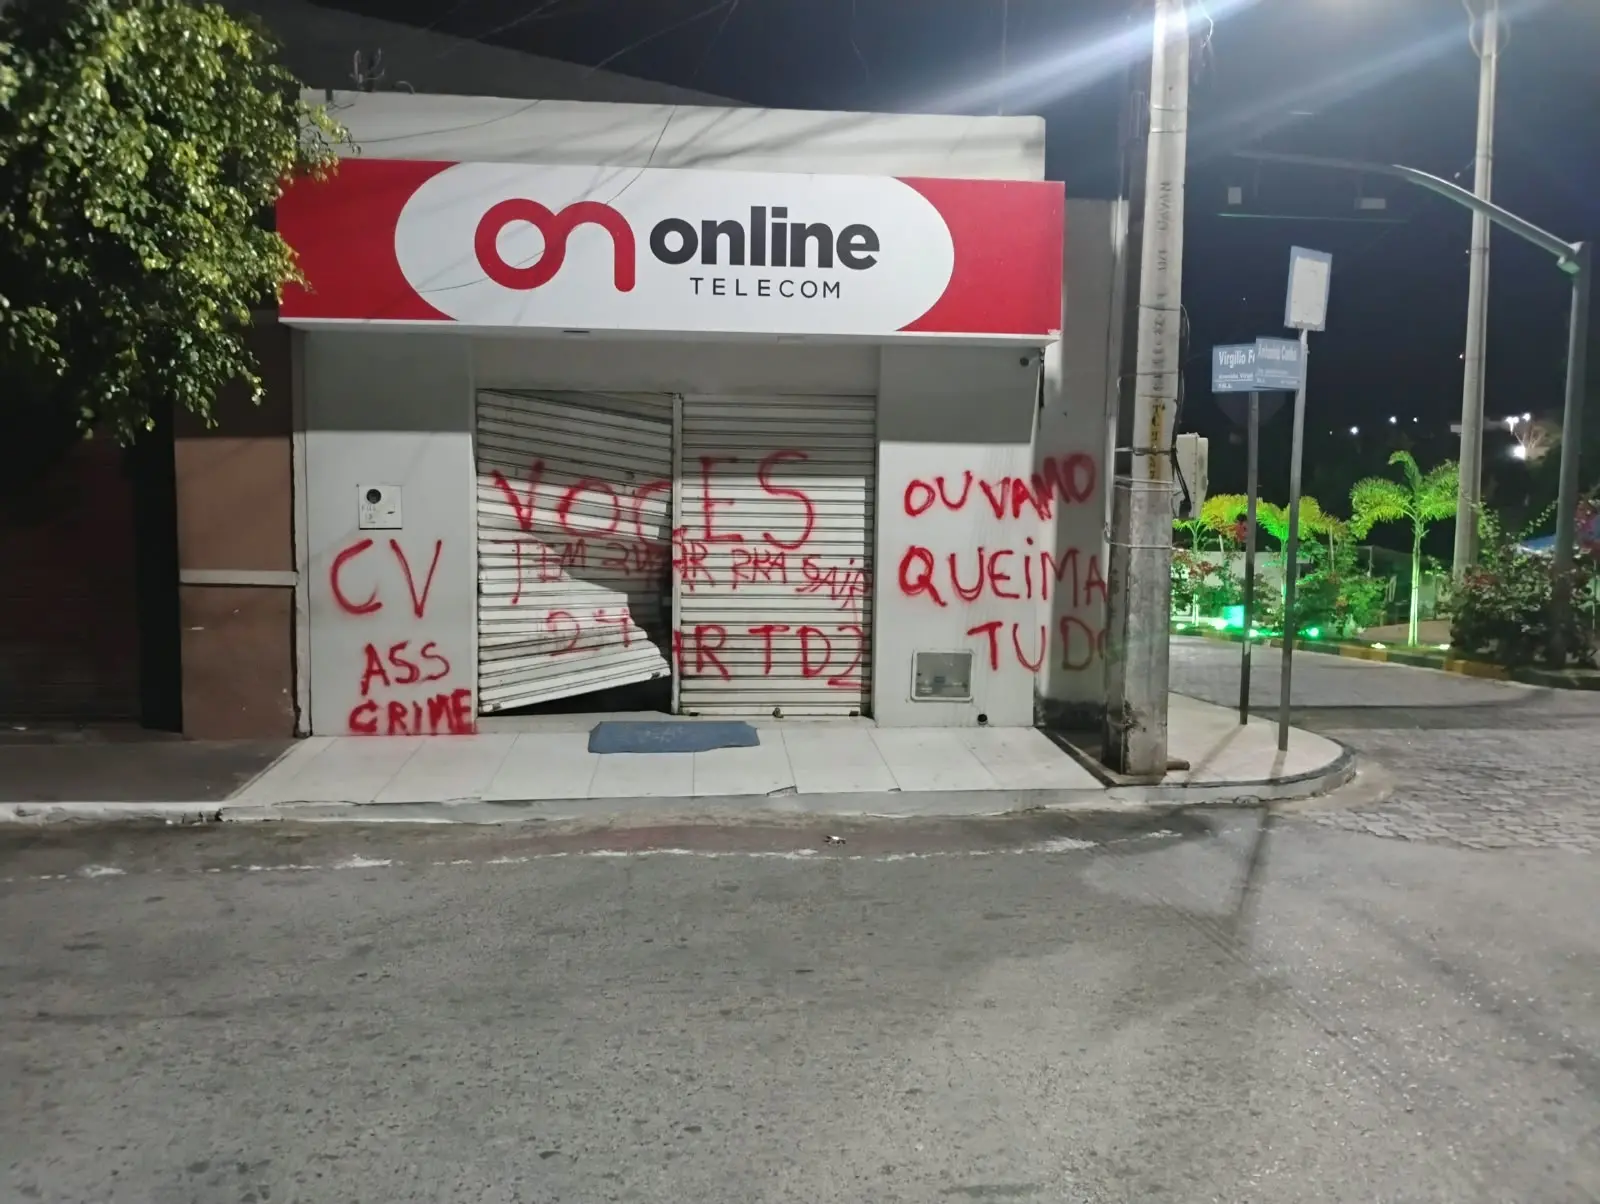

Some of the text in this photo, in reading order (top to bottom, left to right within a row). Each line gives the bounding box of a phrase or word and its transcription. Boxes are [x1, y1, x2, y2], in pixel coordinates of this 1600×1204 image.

[649, 206, 880, 271] online
[689, 277, 841, 298] TELECOM
[330, 537, 442, 618] CV
[360, 640, 450, 696] ASS
